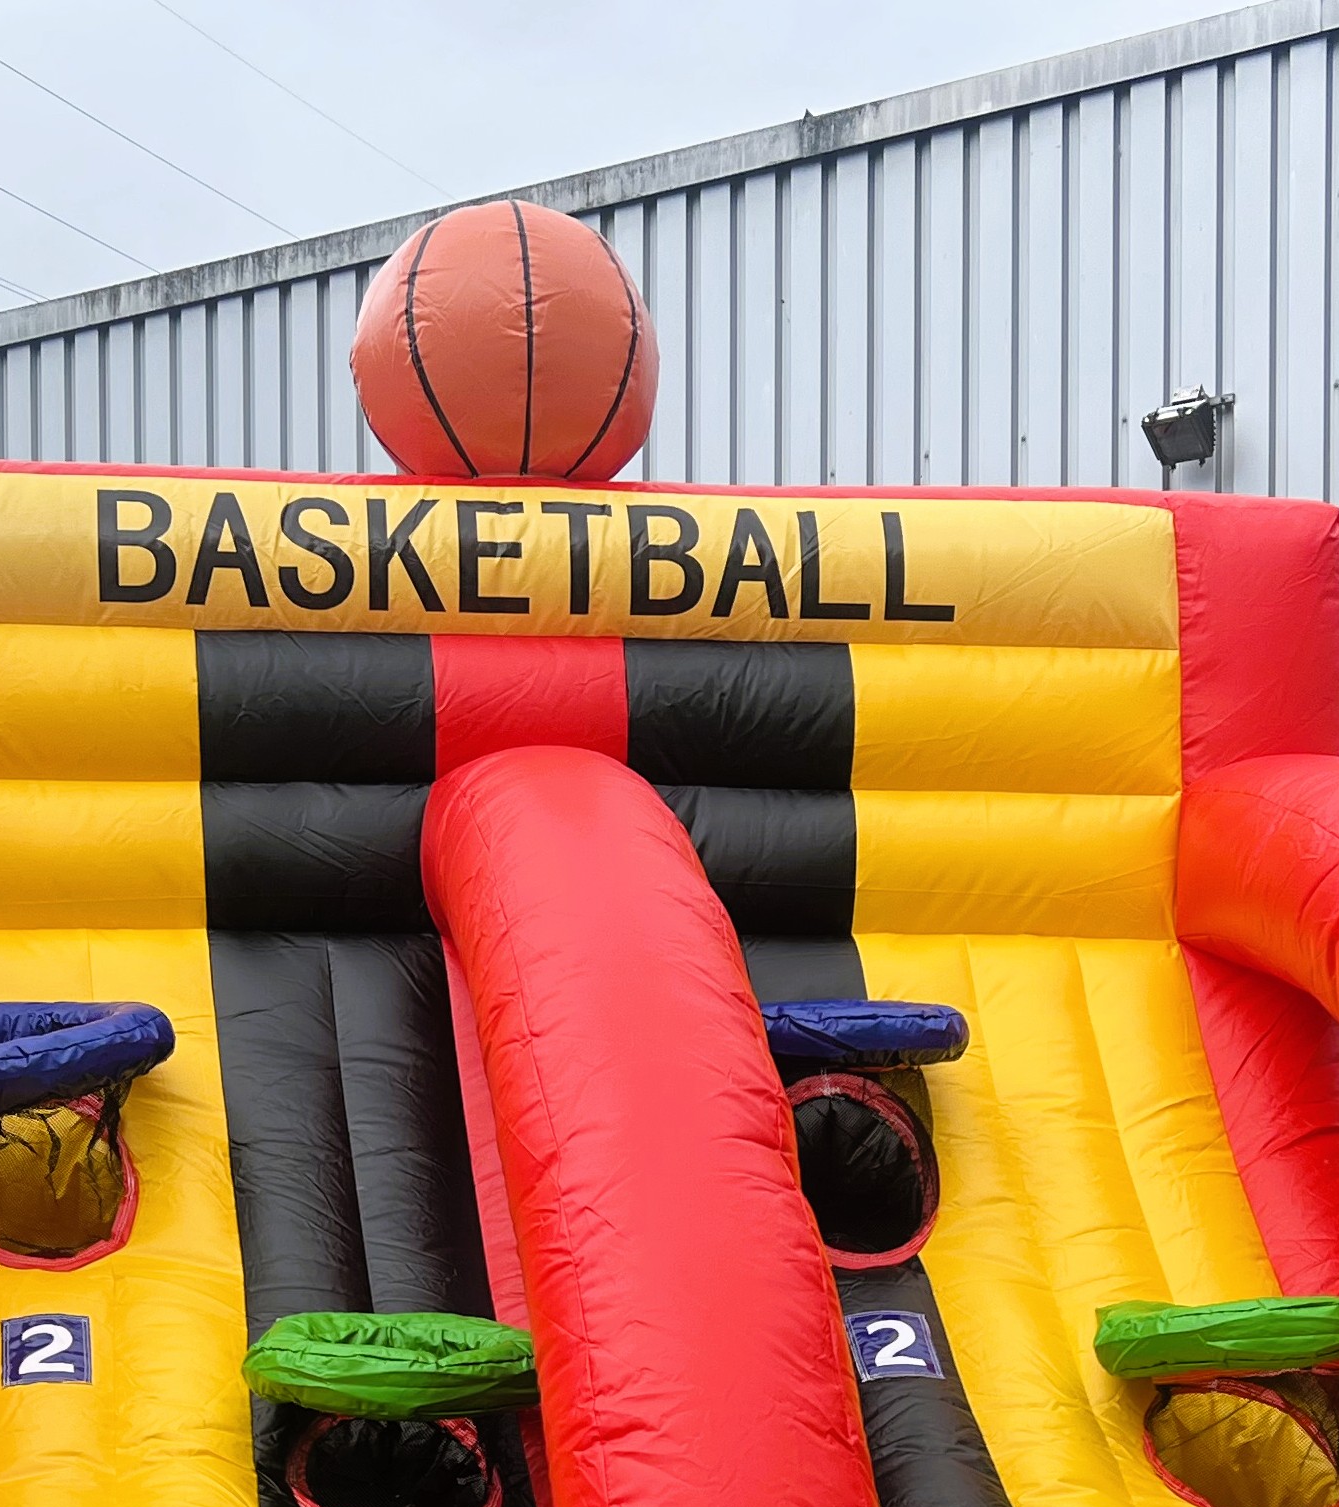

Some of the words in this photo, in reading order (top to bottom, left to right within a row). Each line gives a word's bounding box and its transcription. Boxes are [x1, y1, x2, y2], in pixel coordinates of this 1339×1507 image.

[97, 489, 956, 622] BASKETBALL
[18, 1323, 75, 1375] 2
[866, 1319, 927, 1367] 2
